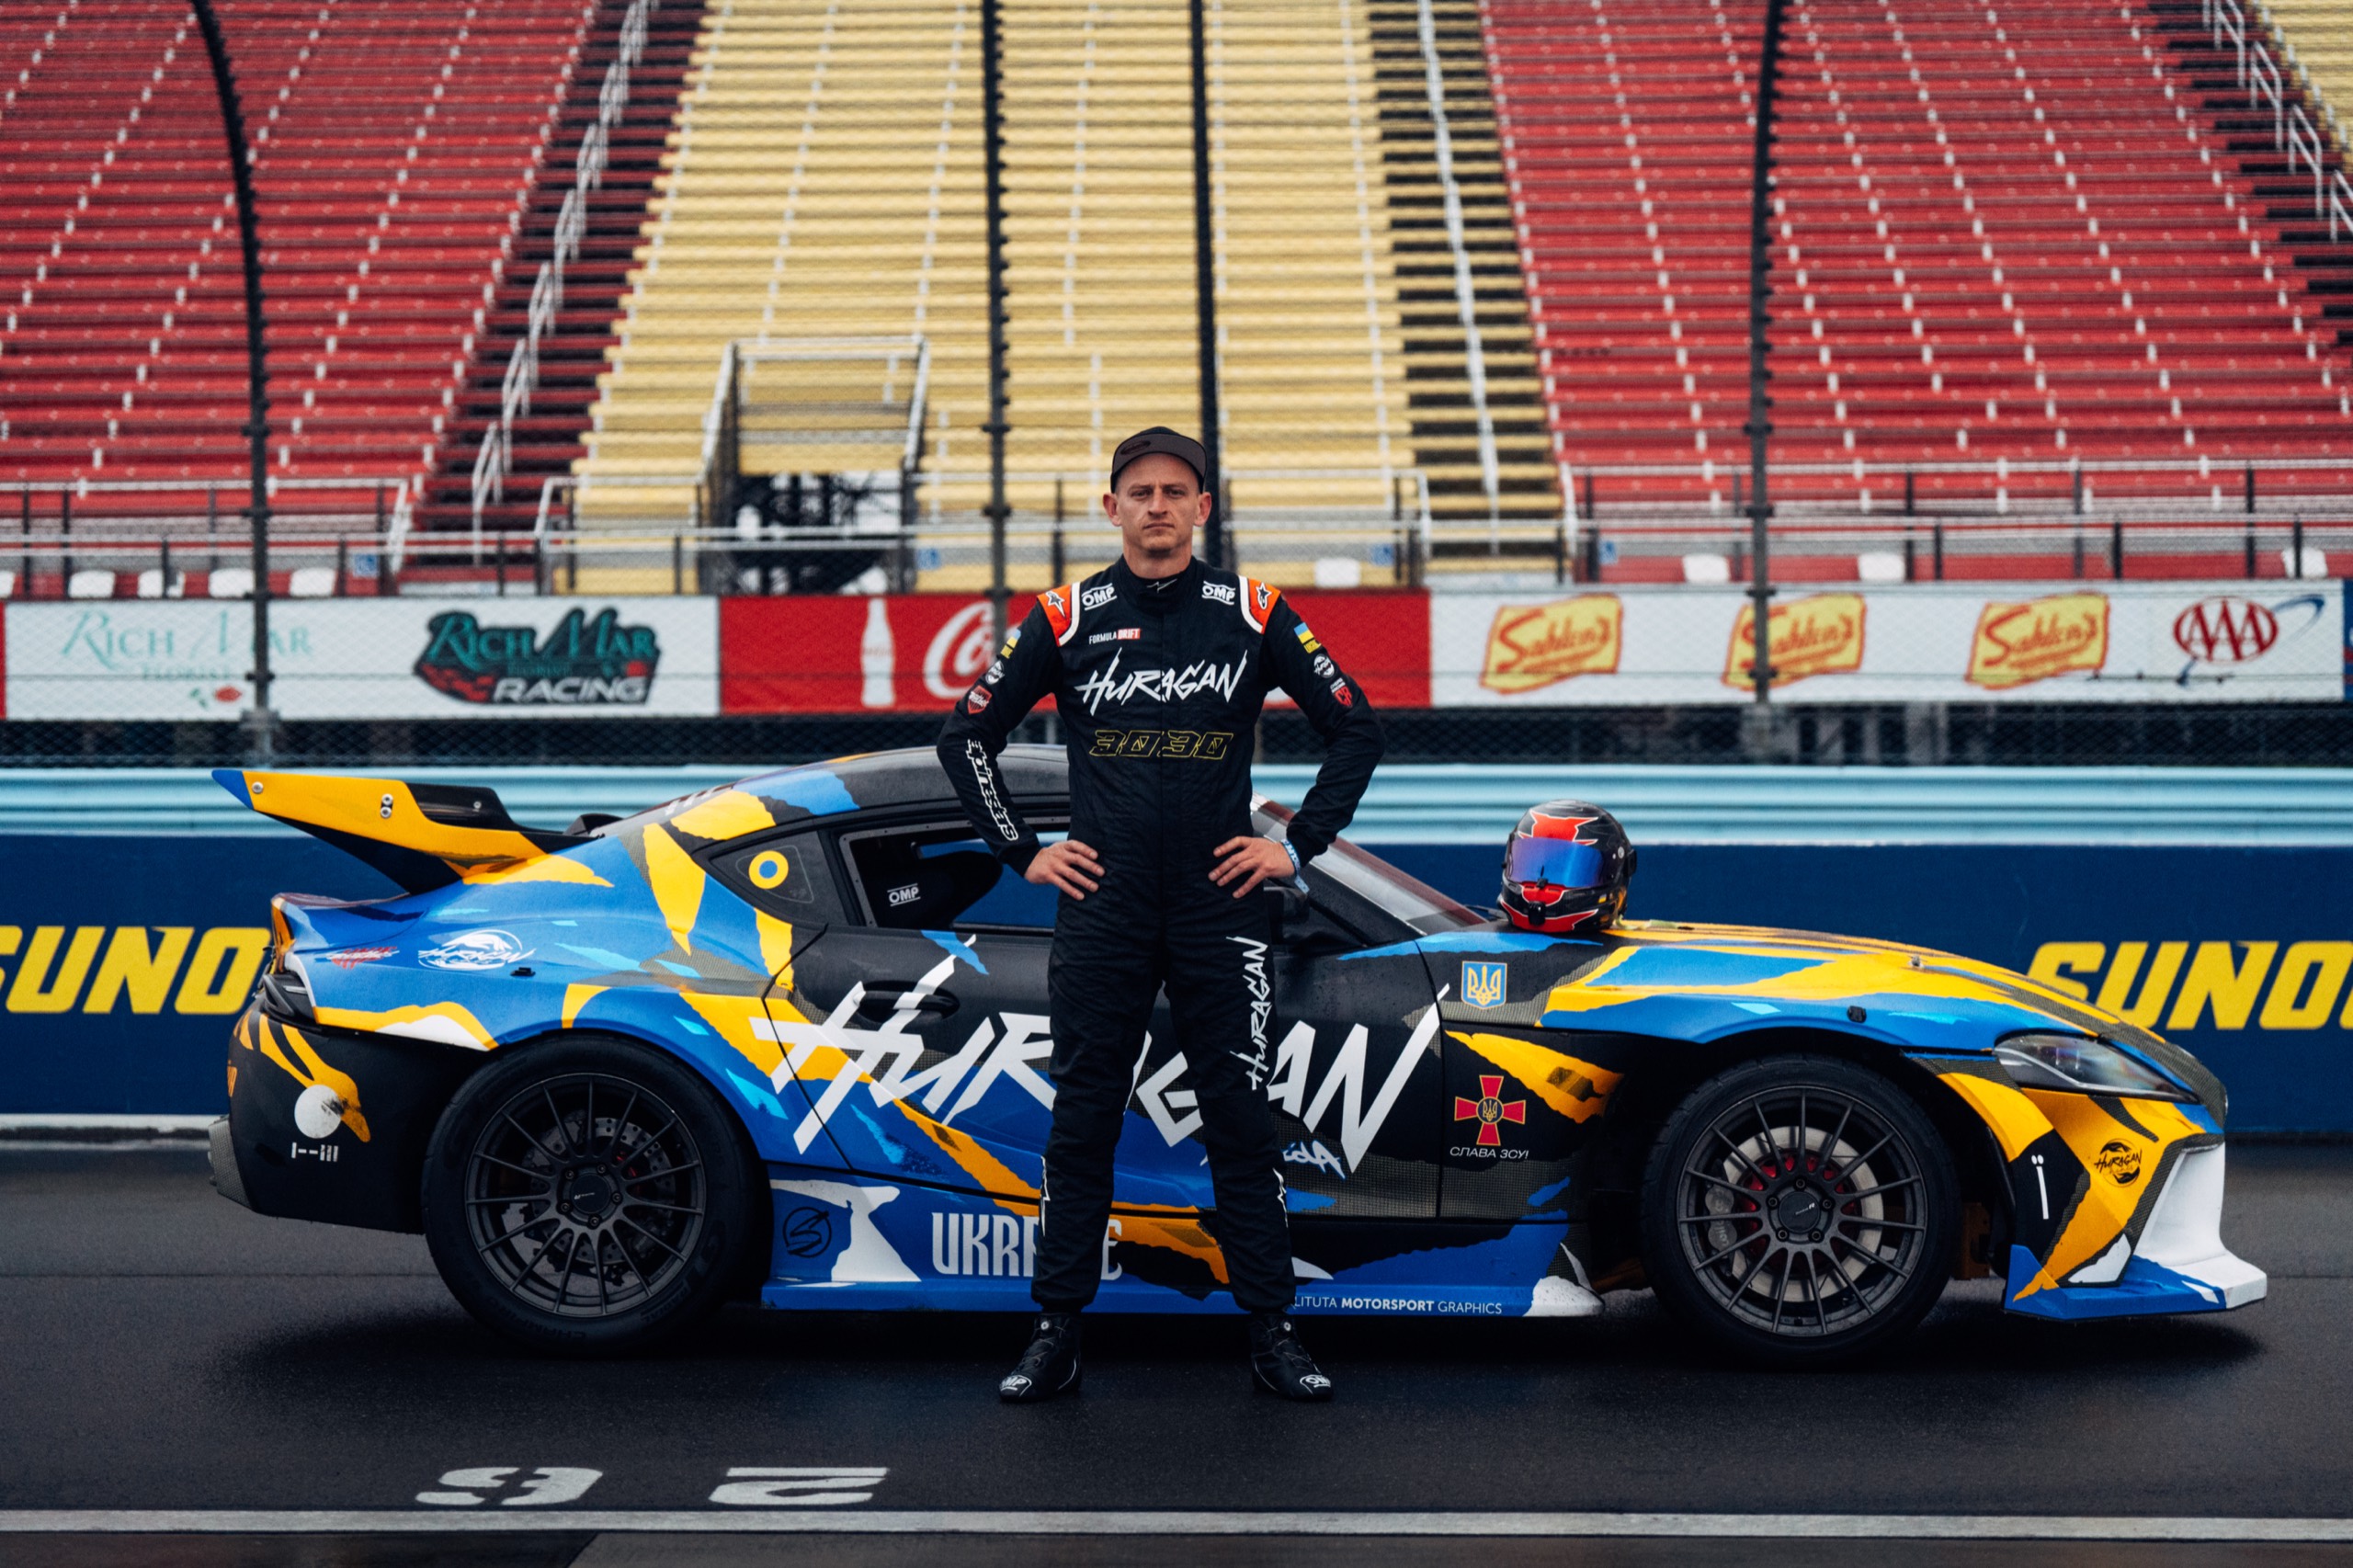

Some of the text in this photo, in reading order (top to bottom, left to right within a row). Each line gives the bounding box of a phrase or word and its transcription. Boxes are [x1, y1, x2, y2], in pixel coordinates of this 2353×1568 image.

[1082, 585, 1116, 608] OMP
[1202, 583, 1235, 603] OMP
[1089, 629, 1141, 644] FORMULA DRIFT
[2181, 597, 2271, 663] AAA
[493, 676, 647, 703] RACING
[1074, 647, 1248, 716] HURAGAN
[889, 885, 920, 904] OMP
[0, 926, 271, 1015] UNO
[2026, 940, 2353, 1030] SUNO
[1225, 936, 1273, 1091] HURAGAN
[748, 934, 1450, 1174] HURGAN
[1449, 1146, 1529, 1160] СЛАВА ЗСУ!
[2094, 1148, 2143, 1174] HURAGAN
[1341, 1297, 1435, 1312] MOTORSPORT
[1438, 1300, 1503, 1315] GRAPHICS
